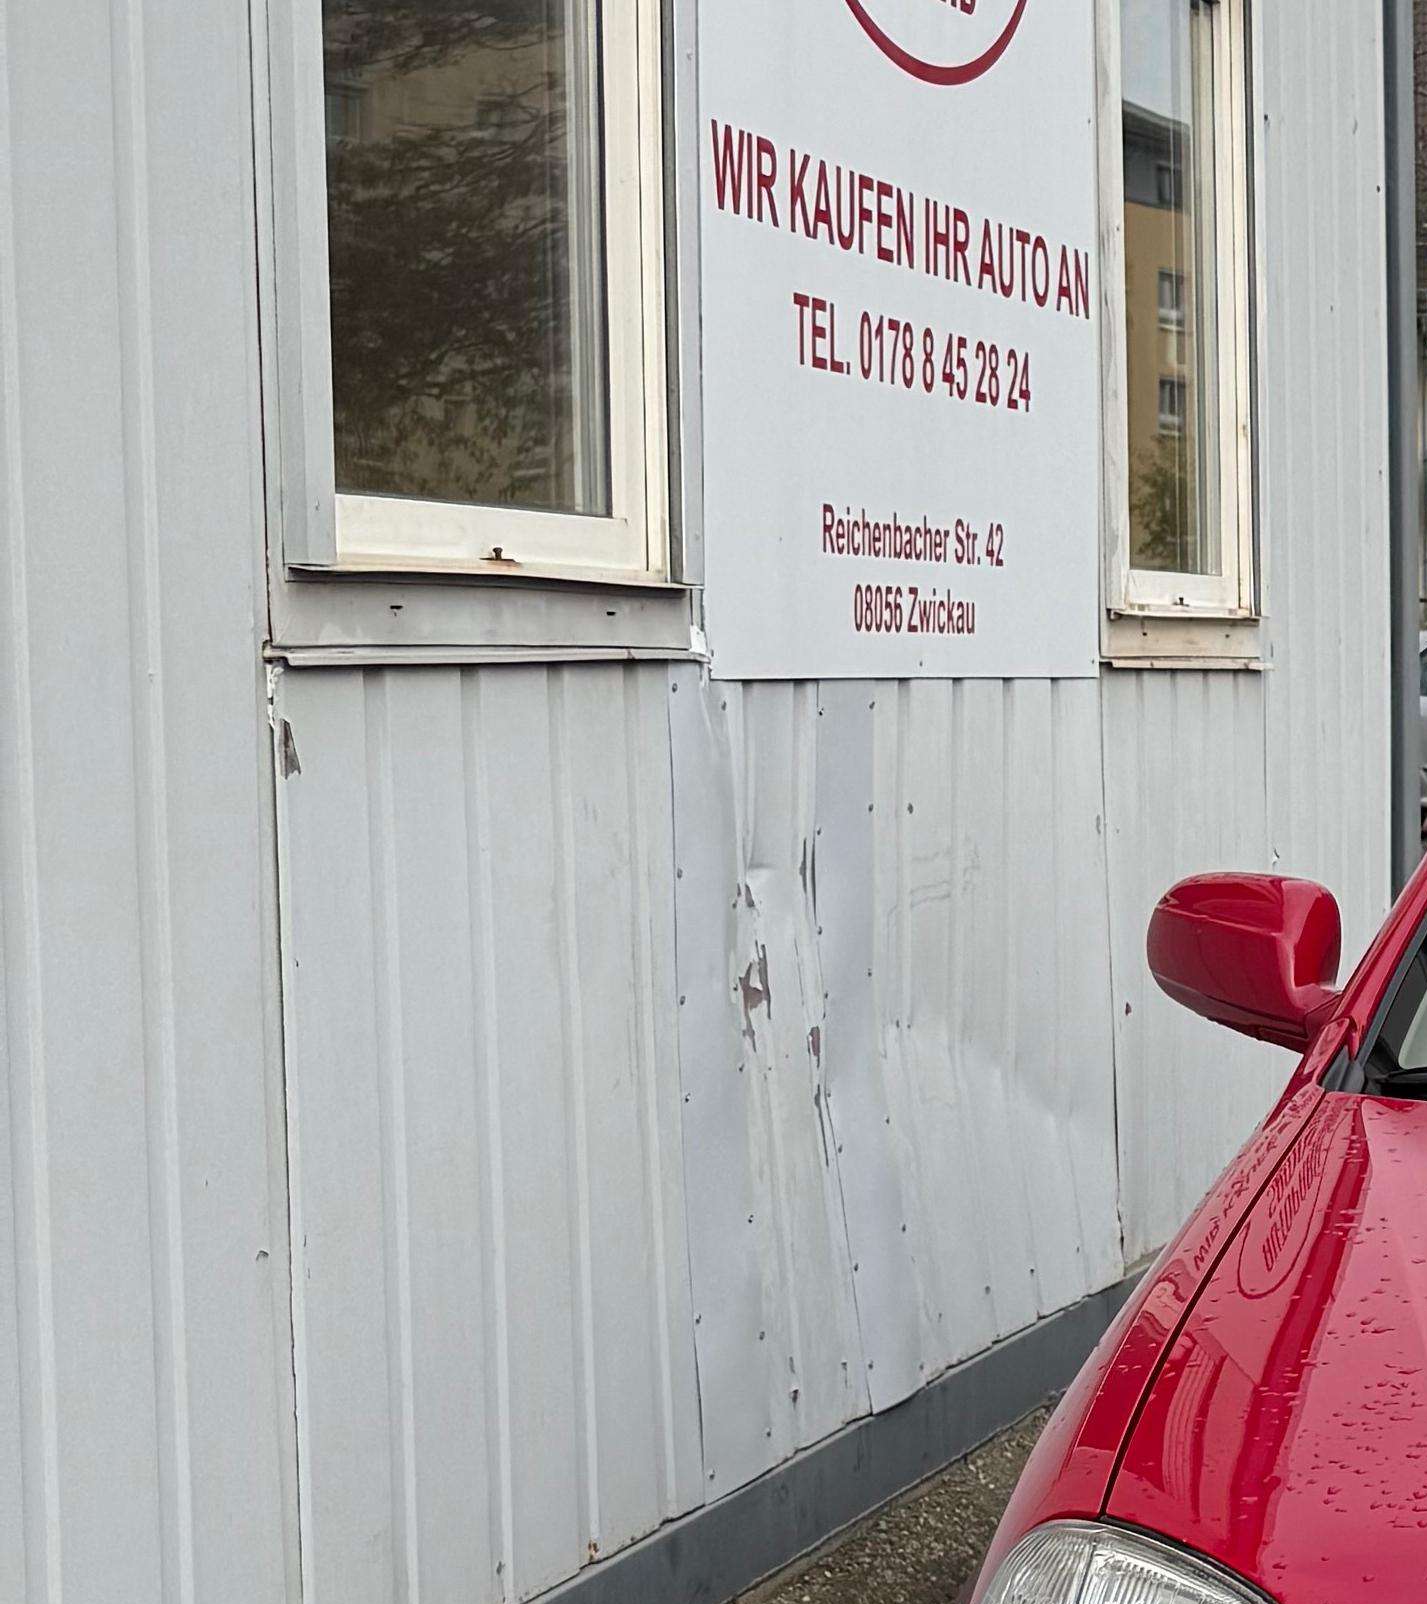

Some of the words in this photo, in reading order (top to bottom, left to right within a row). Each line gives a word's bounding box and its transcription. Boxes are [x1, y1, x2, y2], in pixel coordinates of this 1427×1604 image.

[711, 119, 779, 227] WIR
[790, 149, 914, 269] KAUFEN
[925, 198, 971, 286] IHR
[978, 219, 1049, 307] AUTO
[1057, 245, 1089, 319] AN
[793, 293, 850, 375] TEL.
[860, 311, 914, 388] 0178
[923, 328, 934, 393] 8
[942, 333, 967, 400] 45
[975, 341, 999, 406] 28
[1007, 349, 1030, 412] 24
[823, 504, 949, 562] Reichenbacher
[955, 519, 980, 564] Str.
[986, 523, 1003, 566] 42
[855, 584, 902, 633] 08056
[908, 587, 974, 634] Zwickau
